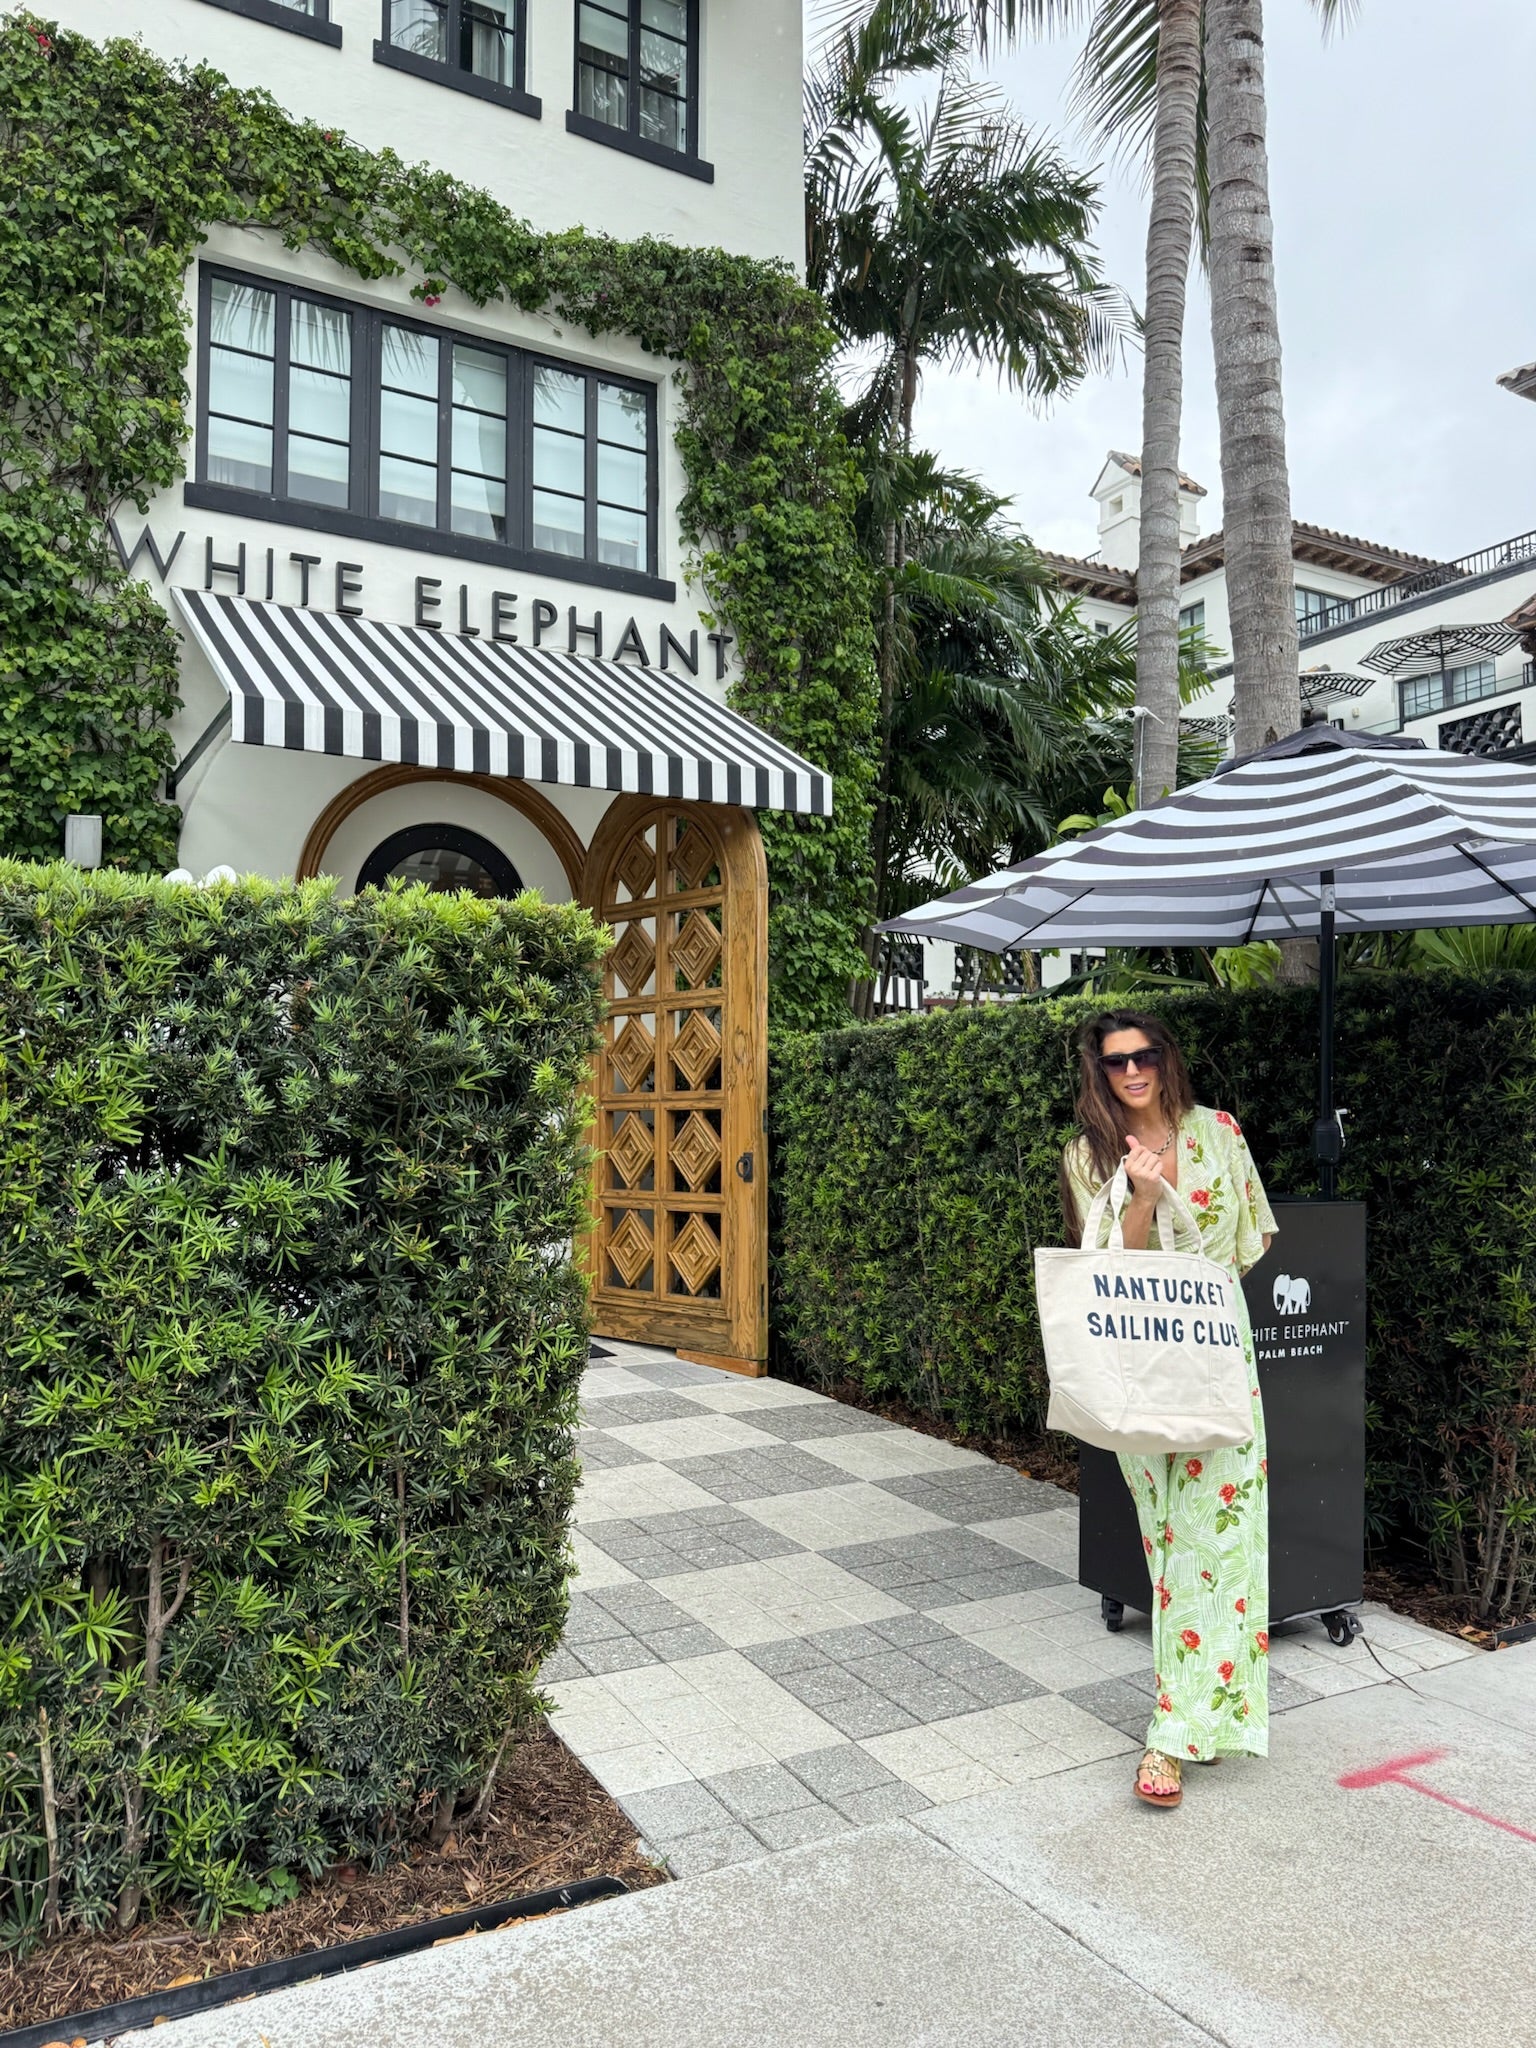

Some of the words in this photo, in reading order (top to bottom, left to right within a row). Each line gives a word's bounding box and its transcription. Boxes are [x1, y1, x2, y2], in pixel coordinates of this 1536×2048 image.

[108, 517, 364, 616] WHITE
[414, 575, 734, 681] ELEPHANT
[1093, 1274, 1225, 1307] NANTUCKET
[1087, 1312, 1184, 1343] SAILING
[1193, 1320, 1240, 1348] CLUB
[1251, 1327, 1278, 1342] HITE
[1259, 1348, 1286, 1360] PALM
[1291, 1344, 1323, 1357] BEACH
